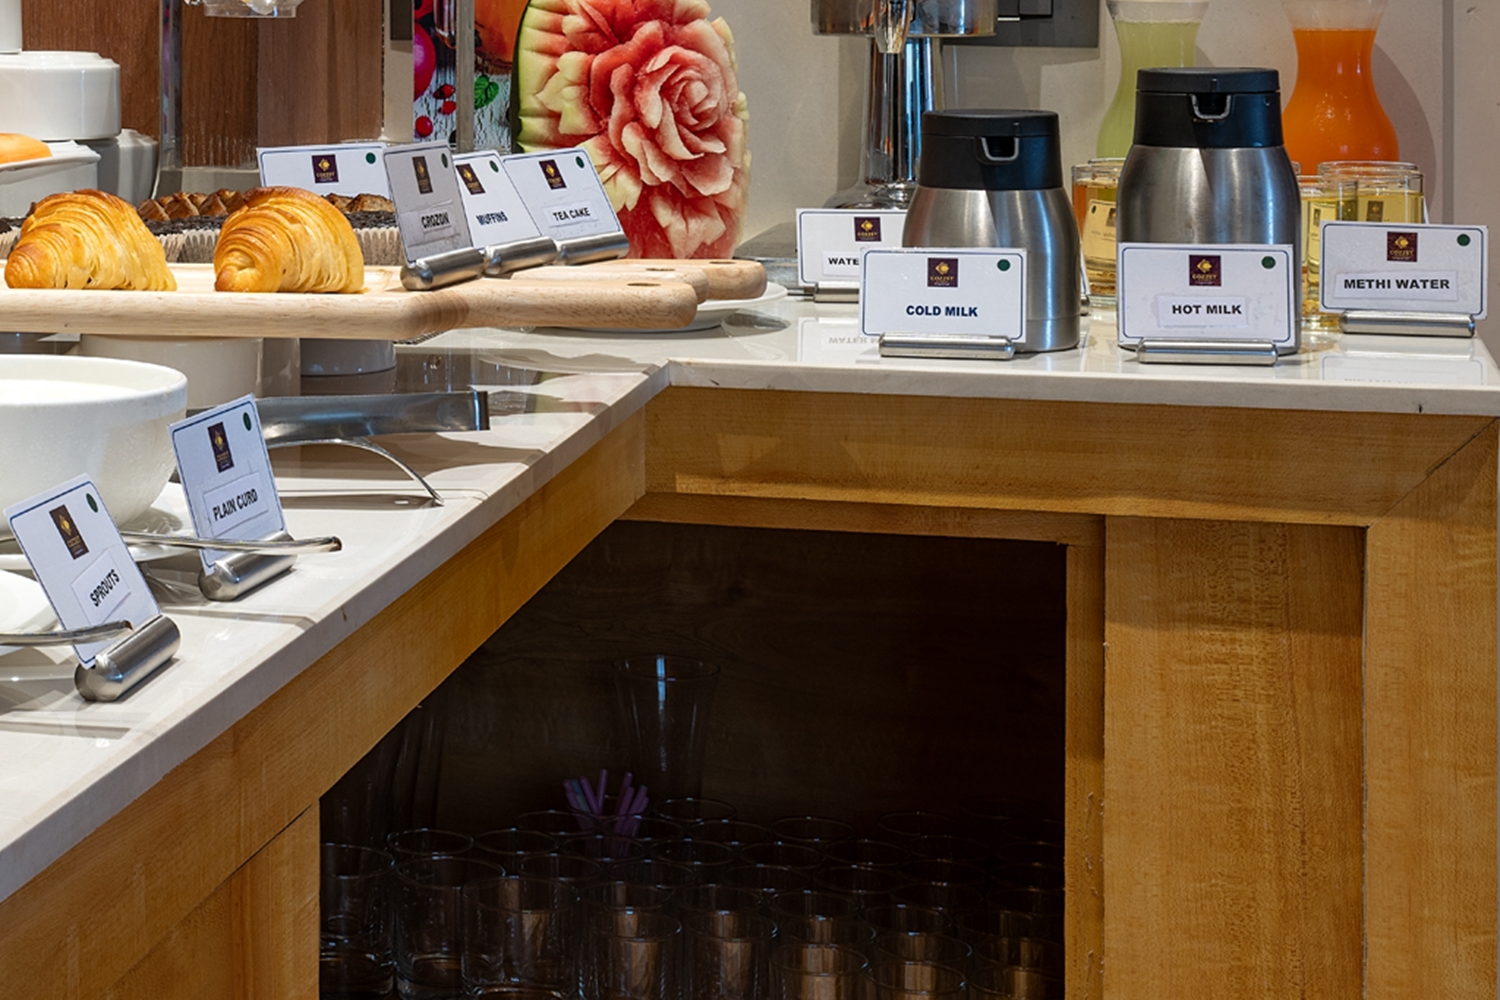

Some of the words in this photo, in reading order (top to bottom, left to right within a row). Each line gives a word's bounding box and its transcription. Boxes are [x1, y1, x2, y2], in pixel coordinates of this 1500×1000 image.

[421, 212, 450, 229] CROZON
[475, 211, 509, 226] MUFFINS
[552, 211, 570, 222] TEA
[569, 207, 591, 219] CAKE
[828, 257, 860, 266] WATE
[1343, 279, 1392, 290] METHI
[1395, 278, 1451, 290] WATER
[905, 305, 942, 317] COLD
[944, 306, 979, 318] MILK
[1172, 304, 1202, 315] HOT
[1206, 304, 1242, 315] MILK
[212, 498, 237, 522] PLAIN
[236, 488, 259, 510] CURD
[89, 568, 120, 608] SPROUTS
